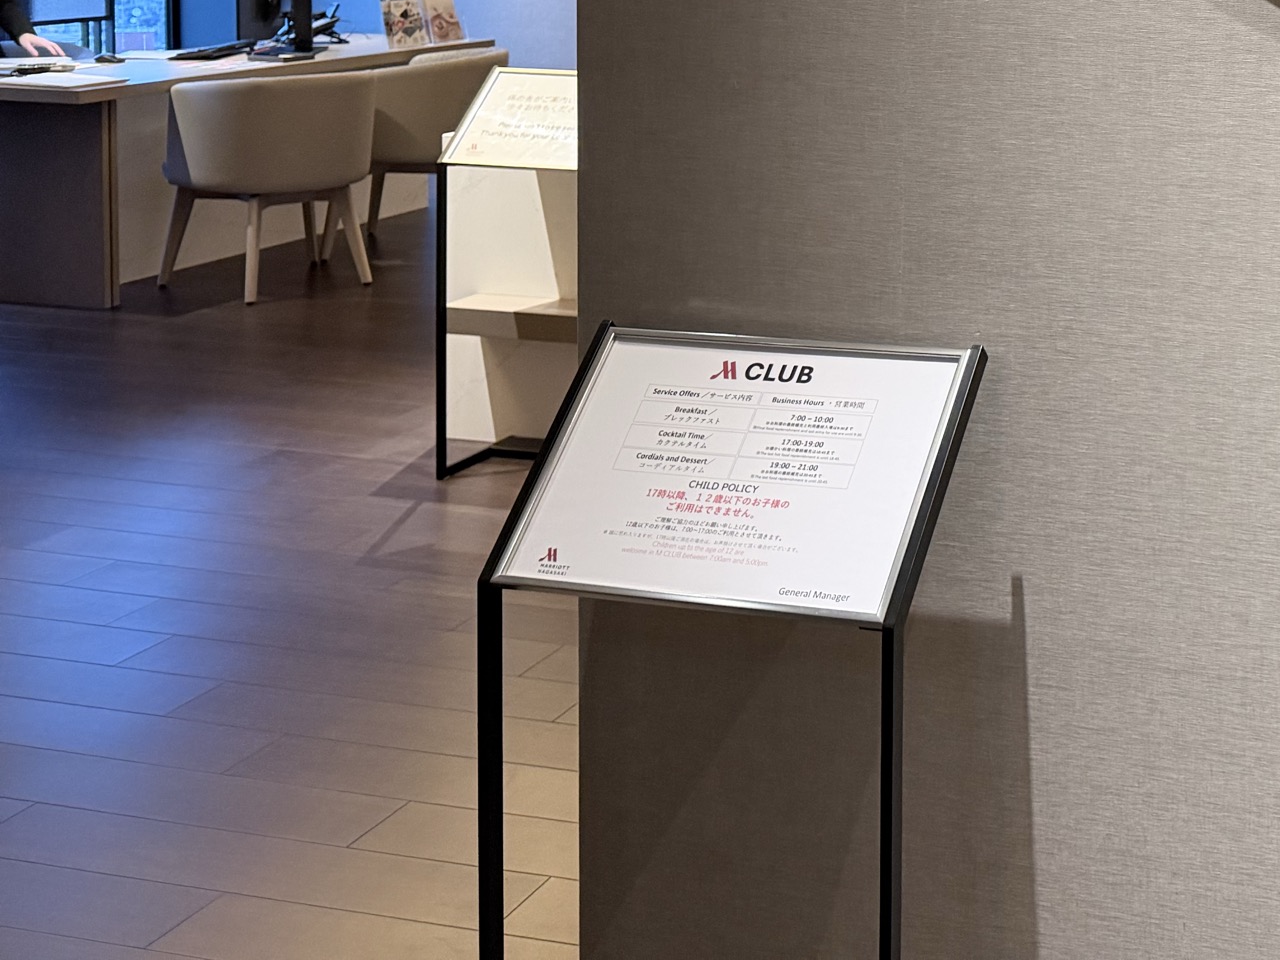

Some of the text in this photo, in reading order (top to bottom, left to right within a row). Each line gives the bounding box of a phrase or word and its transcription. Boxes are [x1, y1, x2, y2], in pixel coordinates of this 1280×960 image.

[745, 362, 814, 384] CLUB
[653, 387, 678, 397] Service
[679, 389, 701, 398] Offers
[771, 396, 801, 406] Business
[803, 399, 824, 407] Hours
[674, 406, 708, 416] Breakfast
[790, 414, 806, 422] 7:00
[813, 415, 835, 424] 10:00
[658, 429, 687, 439] Cocktail
[656, 439, 707, 449] カクテルタイム
[636, 452, 664, 462] Cordials
[665, 454, 679, 463] and
[769, 461, 791, 470] 19:00
[797, 463, 819, 472] 21:00
[688, 480, 760, 494] CHILD POLICY
[666, 502, 755, 519] ご利用はできません。
[778, 587, 850, 602] General Manager
